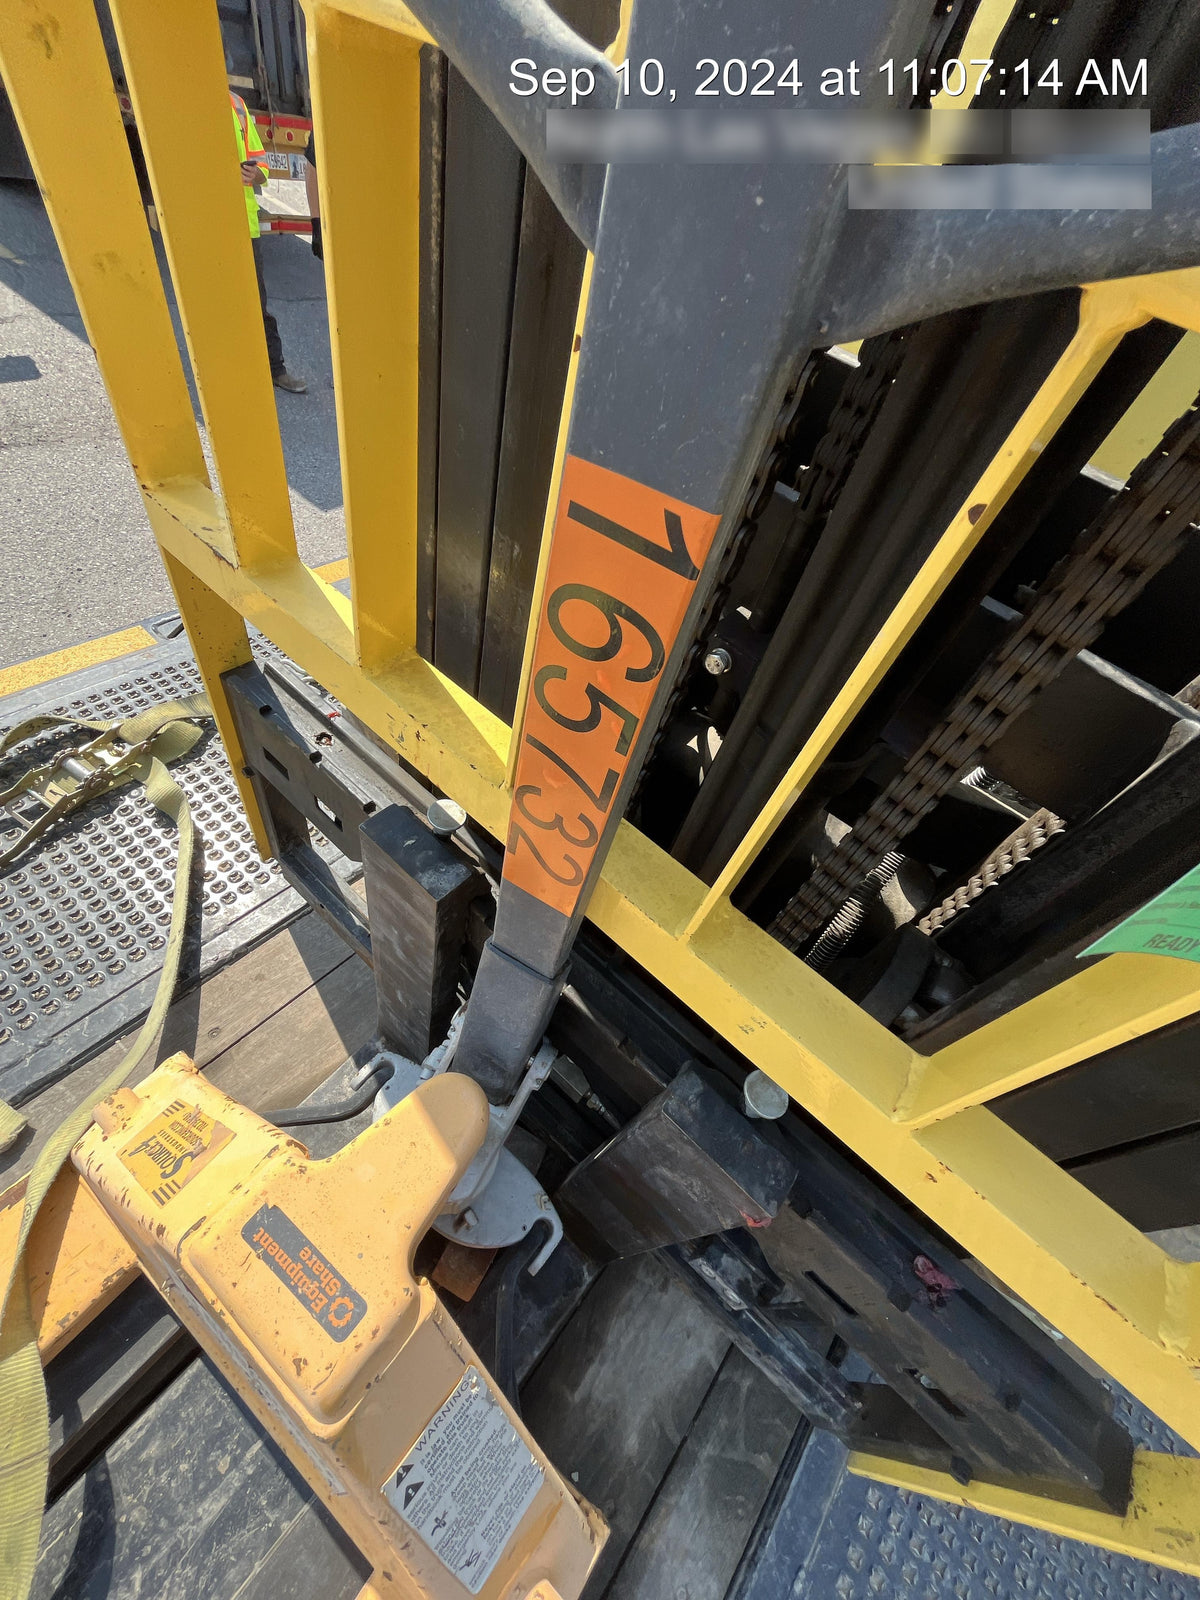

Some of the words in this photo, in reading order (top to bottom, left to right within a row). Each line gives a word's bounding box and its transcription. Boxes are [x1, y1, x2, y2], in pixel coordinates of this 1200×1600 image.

[507, 499, 701, 888] 165732
[252, 1226, 330, 1313] Equipment
[297, 1245, 343, 1296] Share
[415, 1379, 469, 1453] WARNING
